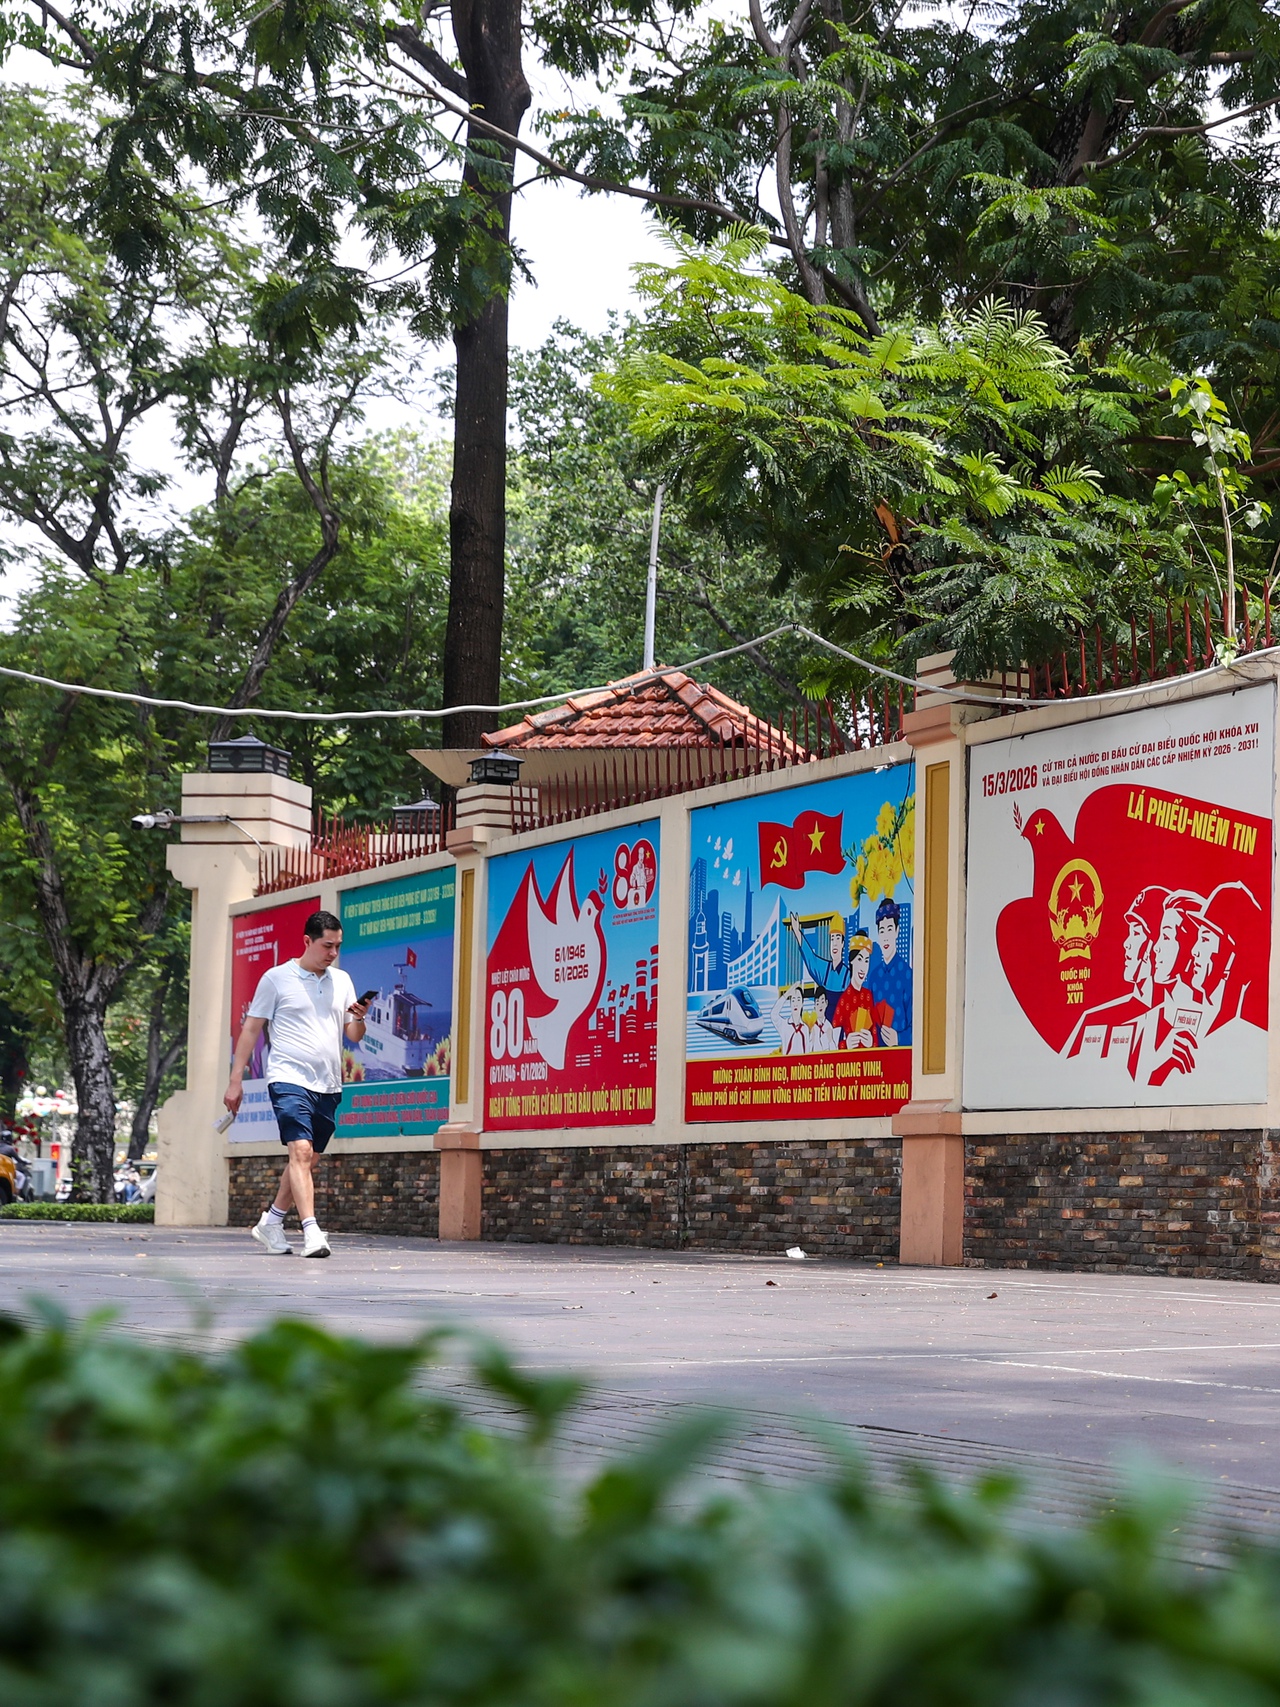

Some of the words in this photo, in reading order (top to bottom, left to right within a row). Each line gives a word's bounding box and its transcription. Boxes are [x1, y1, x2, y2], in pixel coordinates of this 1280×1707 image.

[1042, 759, 1053, 773] CỬ
[1054, 759, 1065, 771] TRI
[1067, 754, 1077, 768] CẢ
[1079, 751, 1100, 766] NƯỚC
[1101, 750, 1109, 762] ĐI
[1111, 745, 1127, 760] BẦU
[1129, 741, 1141, 756] CỬ
[1141, 742, 1156, 755] ĐẠI
[1158, 735, 1176, 751] BIỂU
[1178, 731, 1201, 748] QUỐC
[1203, 729, 1217, 744] HỘI
[1219, 725, 1242, 740] KHÓA
[1245, 722, 1259, 735] XVI
[1042, 775, 1050, 787] VÀ
[1051, 775, 1062, 787] ĐẠI
[1063, 769, 1078, 783] BIỂU
[1079, 768, 1090, 781] HỘI
[1111, 760, 1130, 774] NHÂN
[1131, 757, 1145, 771] DÂN
[1147, 754, 1160, 768] CÁC
[1162, 750, 1176, 765] CẤP
[1178, 748, 1201, 763] NHIỆM
[1202, 745, 1212, 758] KỲ
[1213, 743, 1231, 756] 2026
[1238, 738, 1259, 751] 2031!
[982, 764, 1038, 797] 15/3/2026
[1127, 789, 1146, 821] LÁ
[1146, 796, 1231, 847] PHIẾU-NIỀM
[1232, 821, 1258, 856] TIN
[1060, 966, 1078, 982] QUỐC
[1078, 966, 1091, 981] HỘI
[1066, 981, 1084, 992] KHÓA
[1066, 991, 1084, 1005] XVI
[490, 987, 524, 1060] 80
[523, 1037, 538, 1054] NĂM
[712, 1066, 733, 1084] MỪNG
[734, 1065, 753, 1083] XUÂN
[754, 1064, 771, 1082] BÍNH
[772, 1066, 789, 1085] NGỌ,
[790, 1062, 812, 1081] MỪNG
[814, 1059, 834, 1079] ĐẢNG
[836, 1061, 861, 1079] QUANG
[863, 1060, 883, 1078] VINH,
[489, 1093, 506, 1118] NGÀY
[505, 1088, 521, 1117] TỔNG
[521, 1086, 540, 1116] TUYỂN
[550, 1086, 563, 1115] ĐẦU
[563, 1088, 578, 1114] TIÊN
[578, 1084, 591, 1113] BẦU
[592, 1082, 609, 1115] QUỐC
[610, 1084, 621, 1116] HỘI
[622, 1084, 636, 1115] VIỆT
[637, 1087, 653, 1110] NAM
[692, 1089, 713, 1106] THÀNH
[714, 1086, 728, 1106] PHỐ
[729, 1086, 738, 1105] HỒ
[740, 1087, 751, 1105] CHÍ
[752, 1089, 771, 1105] MINH
[773, 1086, 792, 1104] VỮNG
[793, 1085, 812, 1103] VÀNG
[814, 1082, 830, 1102] TIẾN
[832, 1082, 847, 1101] VÀO
[848, 1080, 858, 1100] KỶ
[860, 1081, 891, 1100] NGUYÊN
[893, 1080, 909, 1100] MỚI
